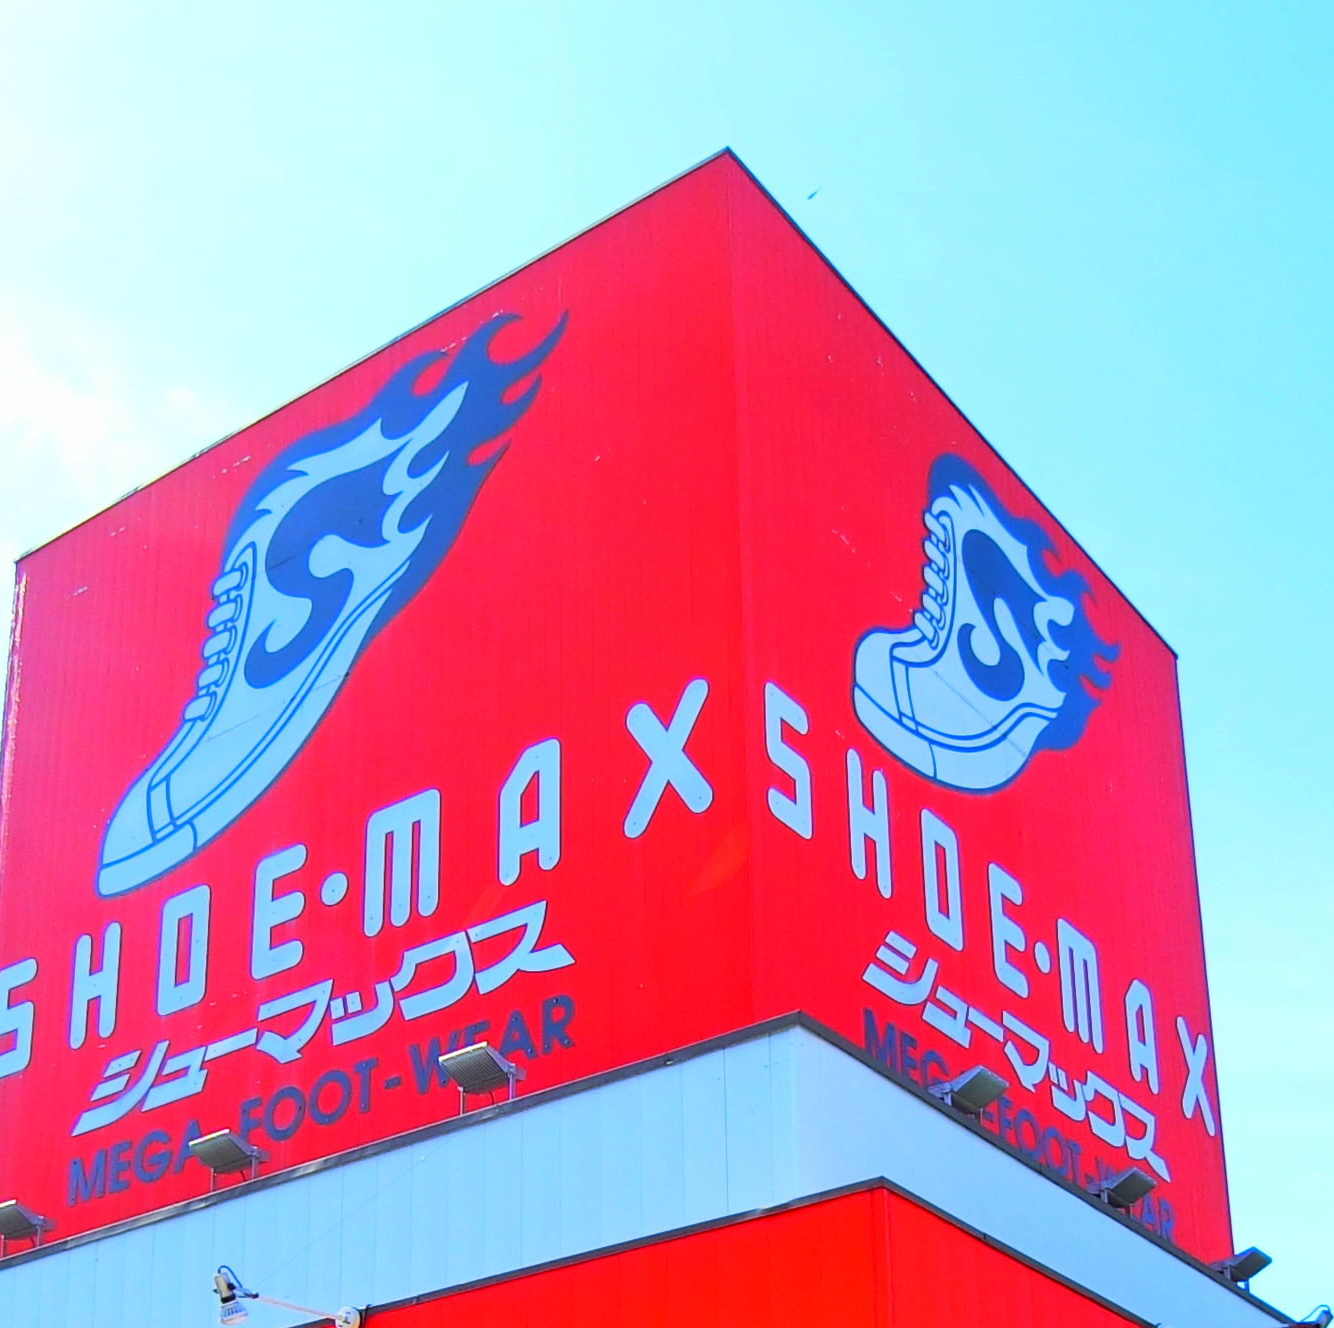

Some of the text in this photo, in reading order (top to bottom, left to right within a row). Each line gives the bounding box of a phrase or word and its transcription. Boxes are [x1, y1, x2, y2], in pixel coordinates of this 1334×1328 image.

[71, 899, 576, 1137] シューマックス
[862, 930, 1171, 1182] シューマックス
